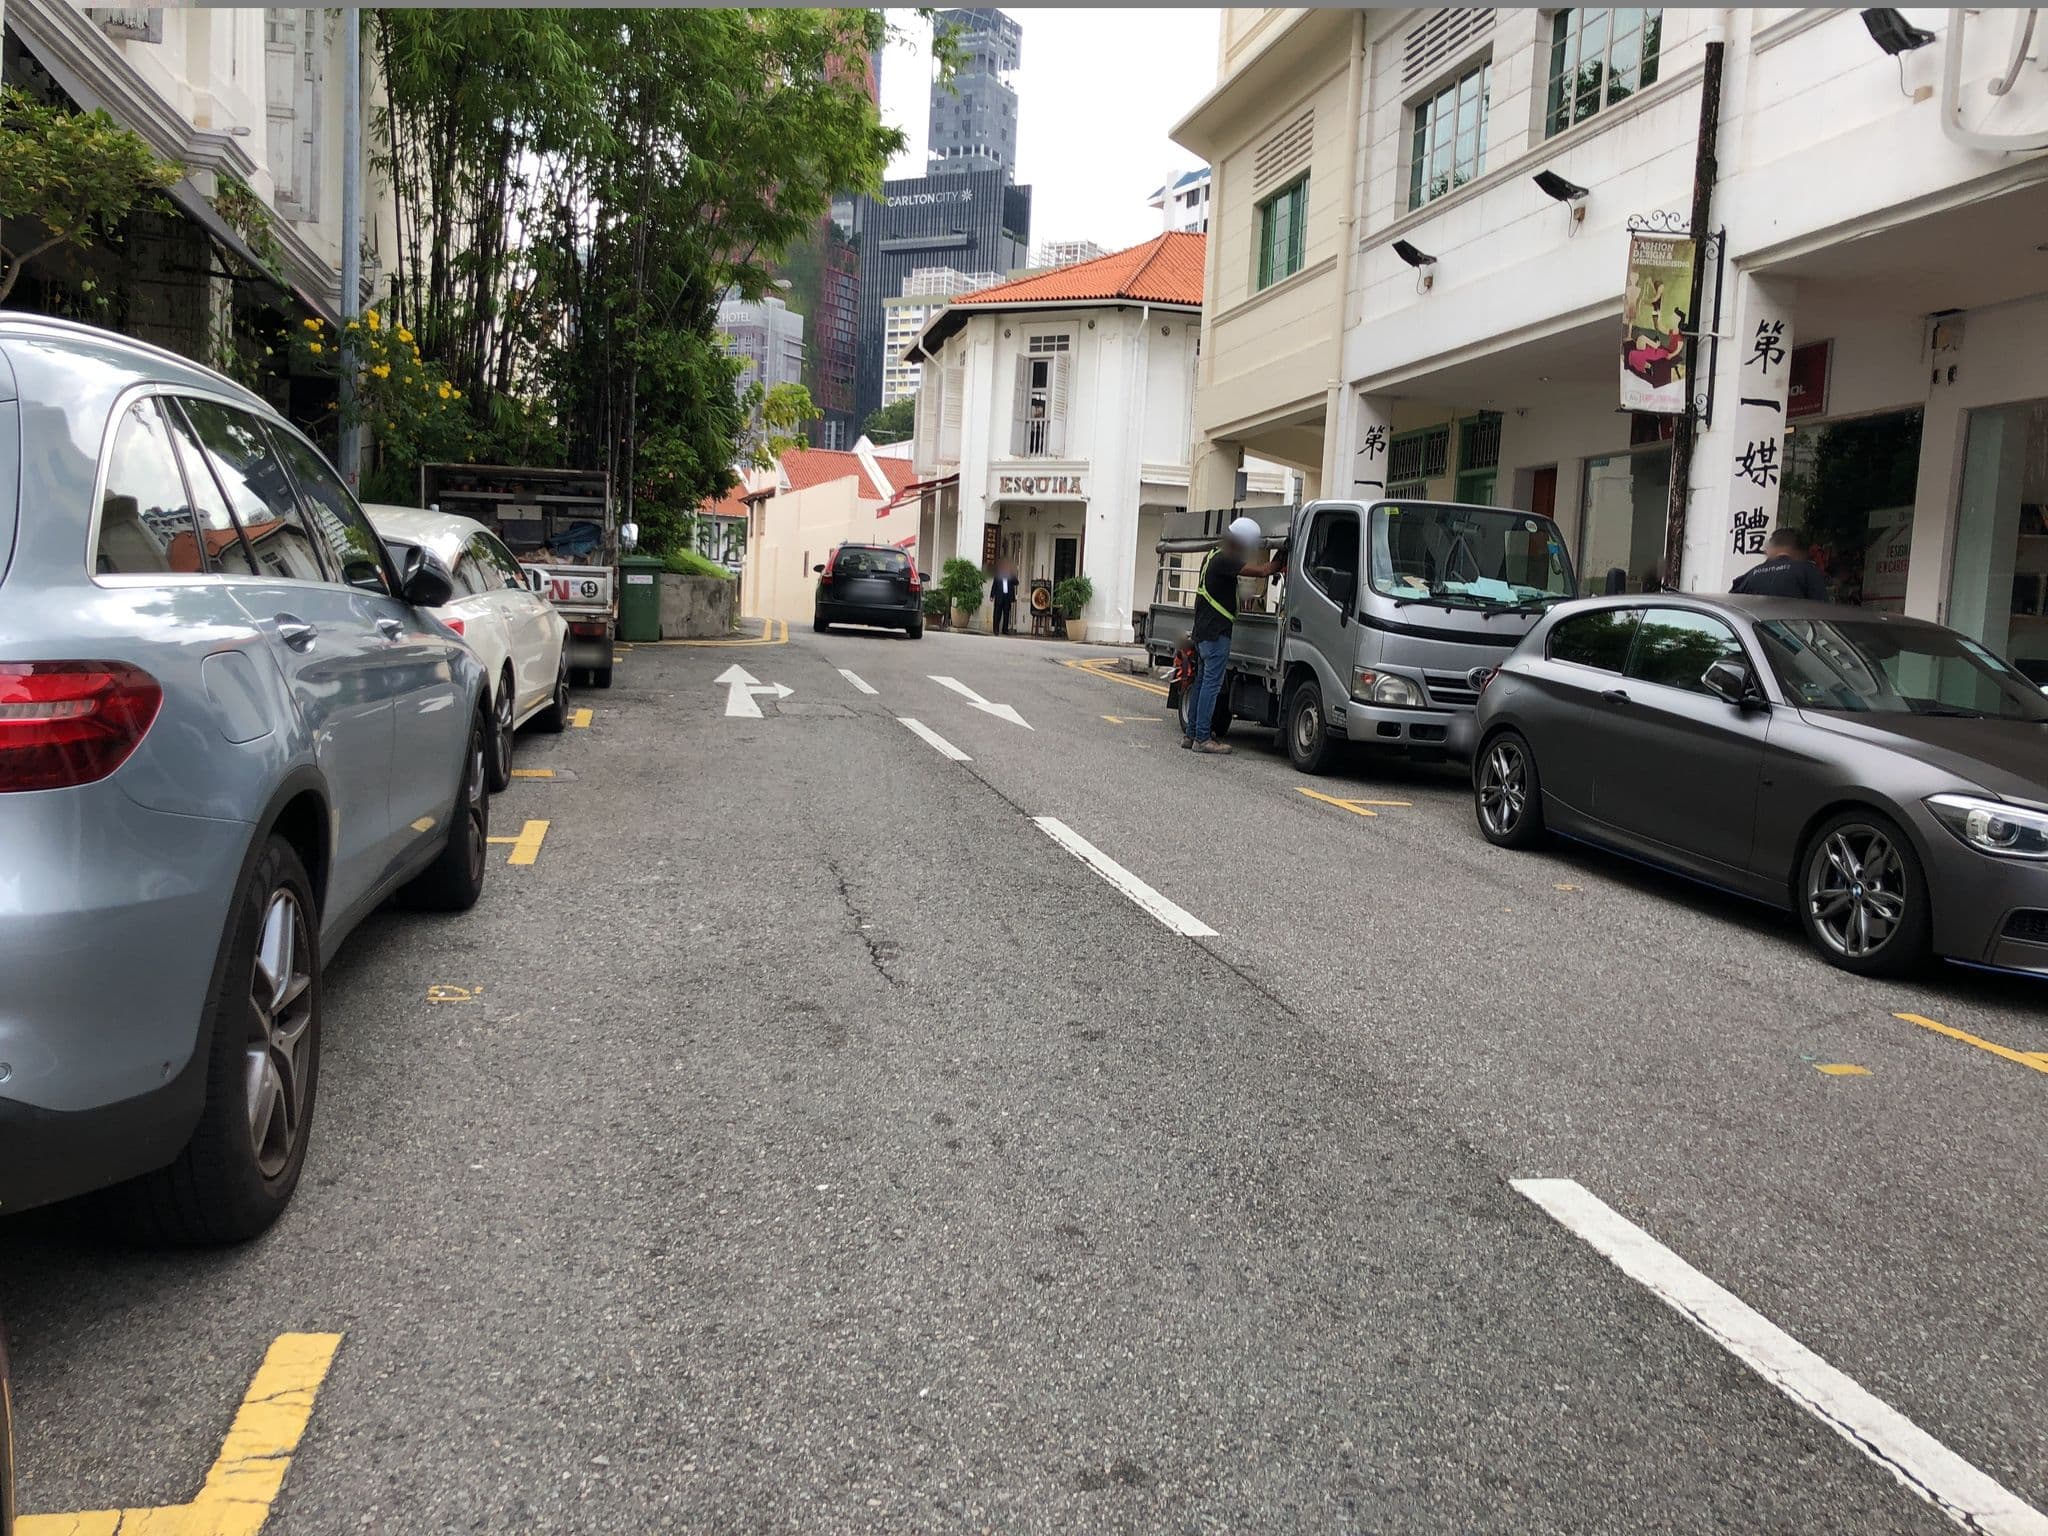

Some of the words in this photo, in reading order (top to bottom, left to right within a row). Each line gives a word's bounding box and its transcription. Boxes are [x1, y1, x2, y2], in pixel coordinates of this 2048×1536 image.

[1634, 241, 1675, 252] FASHION
[1633, 249, 1665, 260] DESIGN
[721, 312, 752, 323] HOTEL
[1730, 319, 1786, 556] 第一媒體
[1354, 424, 1387, 489] 第一
[999, 476, 1083, 496] ESQUINA
[583, 582, 596, 593] 13
